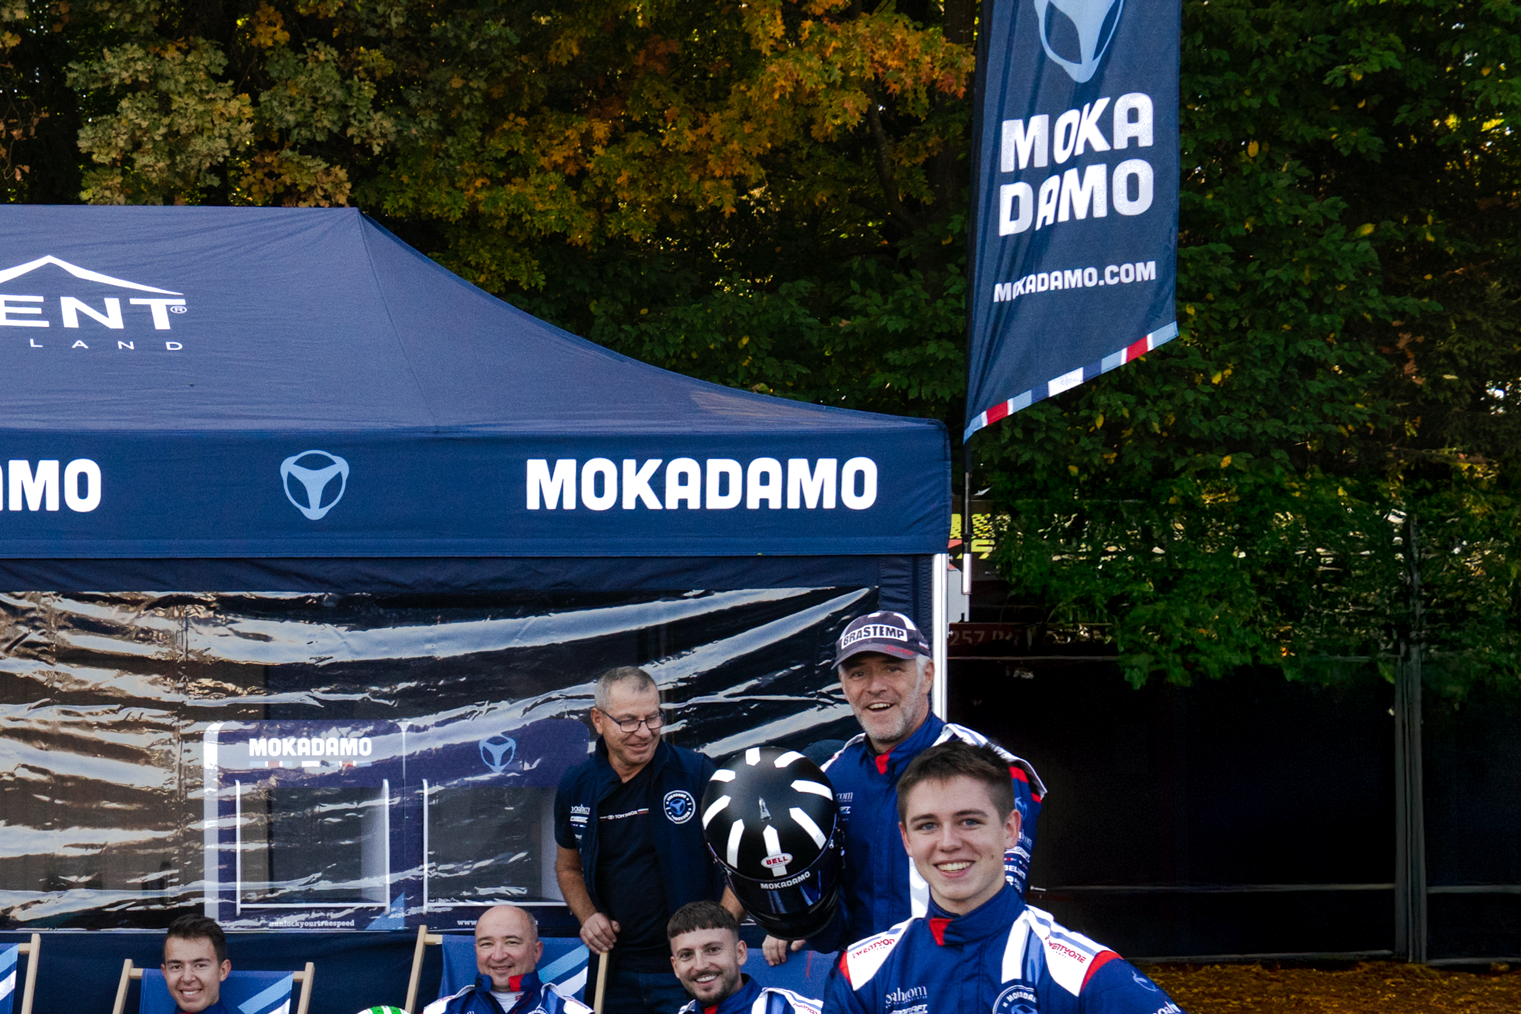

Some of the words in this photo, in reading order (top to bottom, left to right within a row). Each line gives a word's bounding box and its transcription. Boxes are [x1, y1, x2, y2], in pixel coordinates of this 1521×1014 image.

[1001, 93, 1154, 172] MOKA
[999, 158, 1154, 237] DAMO
[993, 261, 1156, 302] MOKADAMO.COM
[527, 457, 878, 510] MOKADAMO
[843, 625, 905, 647] BRASTEMP
[249, 737, 372, 757] MOKADAMO
[766, 856, 788, 866] BELL
[760, 871, 811, 890] MOKADAMO
